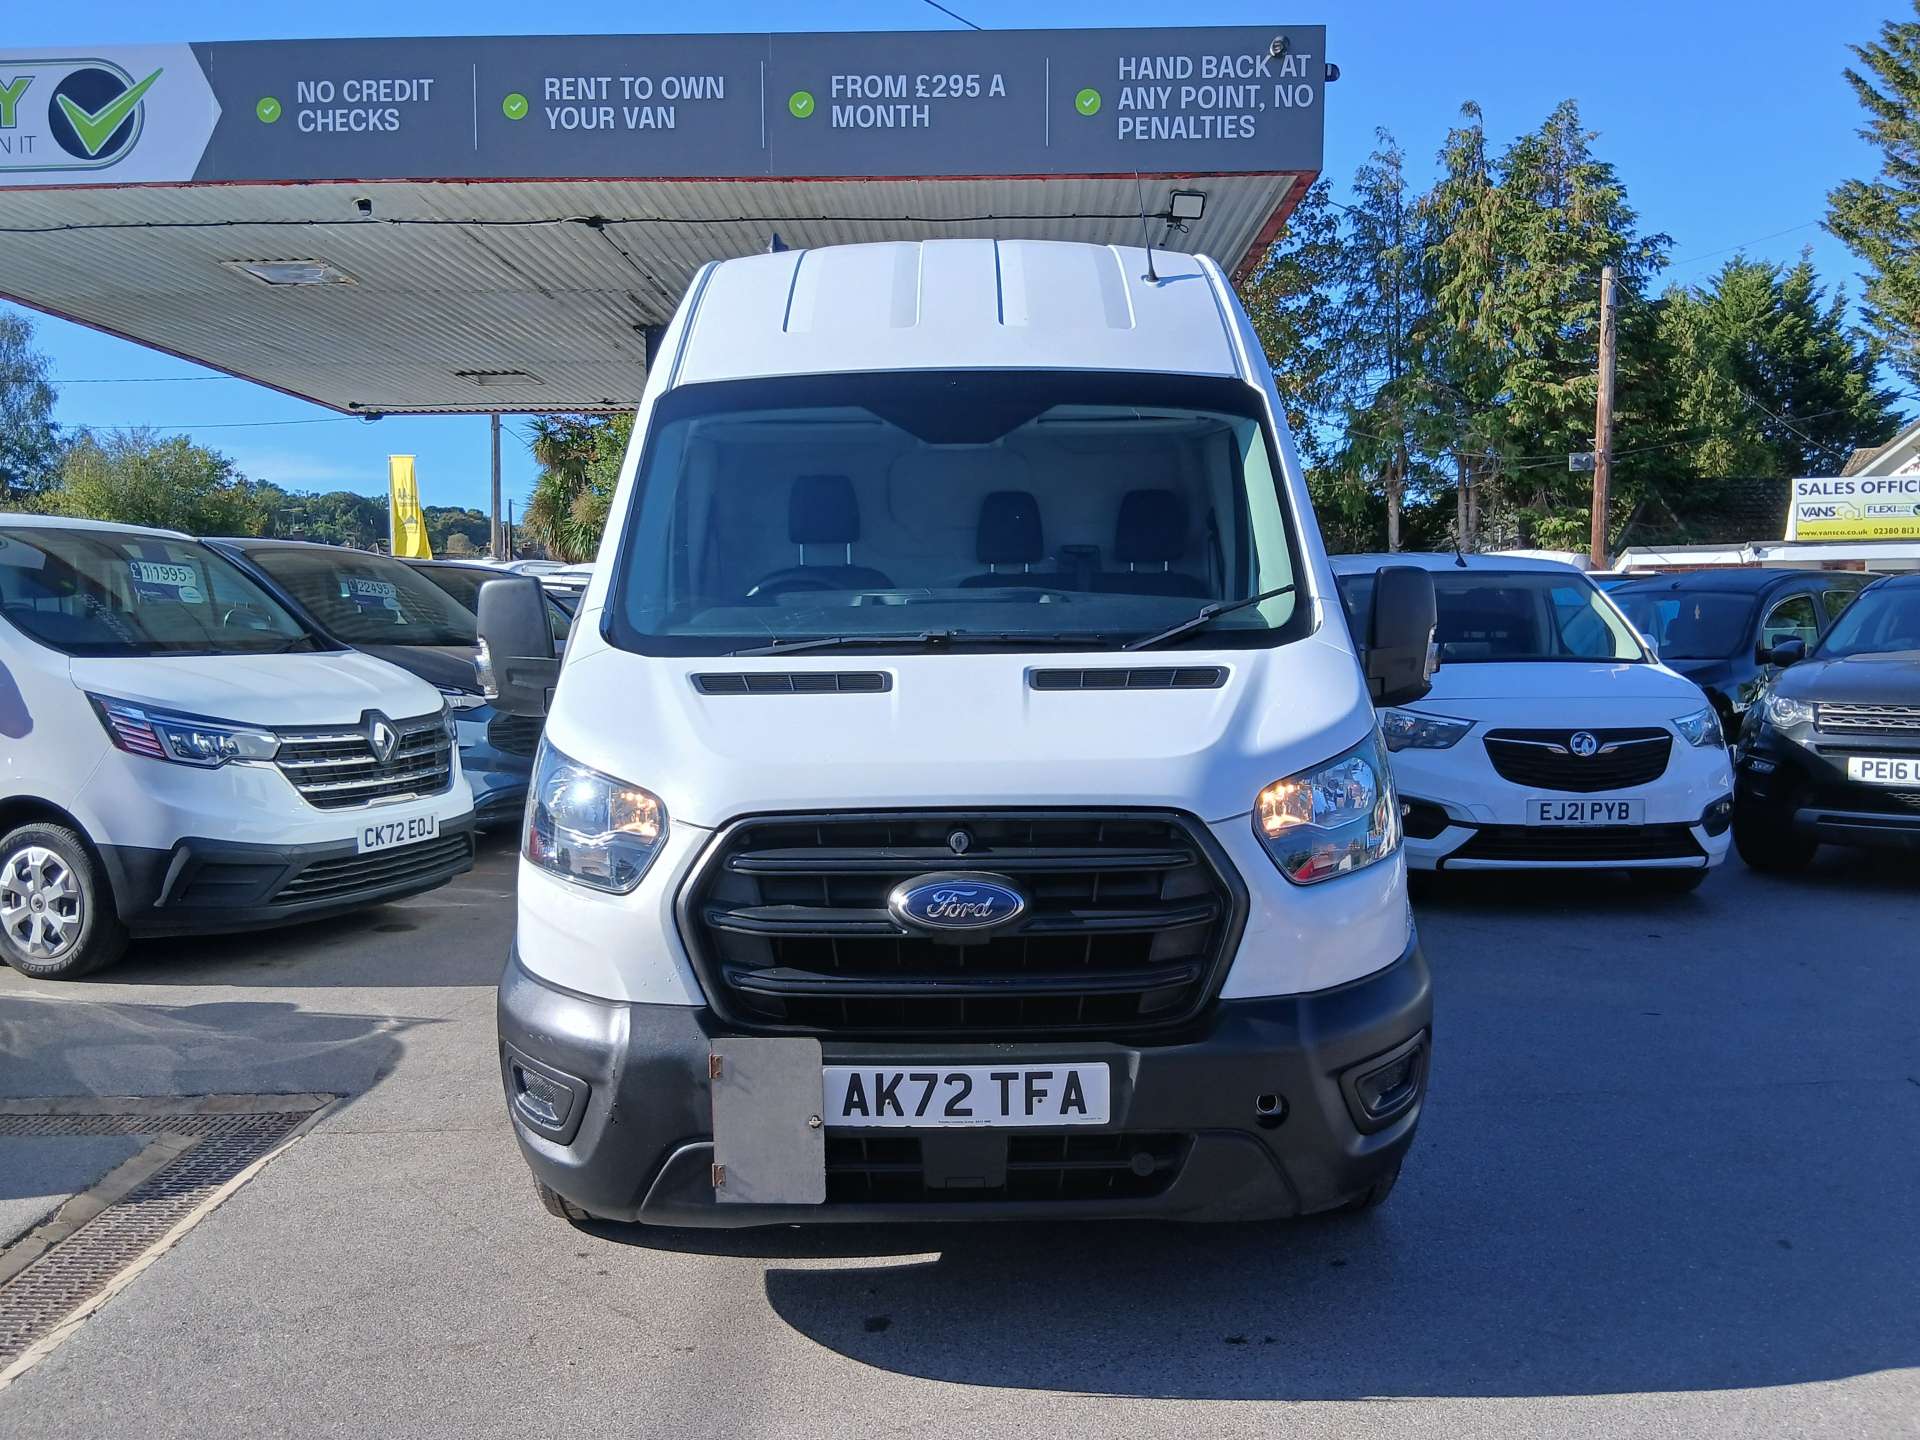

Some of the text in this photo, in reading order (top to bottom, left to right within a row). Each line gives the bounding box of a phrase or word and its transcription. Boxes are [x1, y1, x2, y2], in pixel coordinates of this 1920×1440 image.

[1118, 54, 1311, 80] HAND BACK AT
[297, 79, 434, 103] NO CREDIT
[544, 76, 724, 100] RENT TO OWN
[831, 74, 1006, 98] FROM £295 A
[1118, 84, 1314, 112] ANY POINT, NO
[297, 108, 400, 132] CHECKS
[545, 106, 675, 130] YOUR VAN
[832, 104, 929, 128] MONTH
[1118, 115, 1255, 140] PENALTIES
[20, 135, 37, 153] IT
[1798, 480, 1920, 496] SALES OFFIC
[1867, 505, 1896, 513] FLEXI
[1861, 760, 1908, 779] PE16
[1540, 802, 1630, 821] EJ21 PYB
[364, 816, 434, 847] CK72 EOJ
[927, 889, 994, 917] Ford
[842, 1071, 1087, 1117] AK72 TFA
